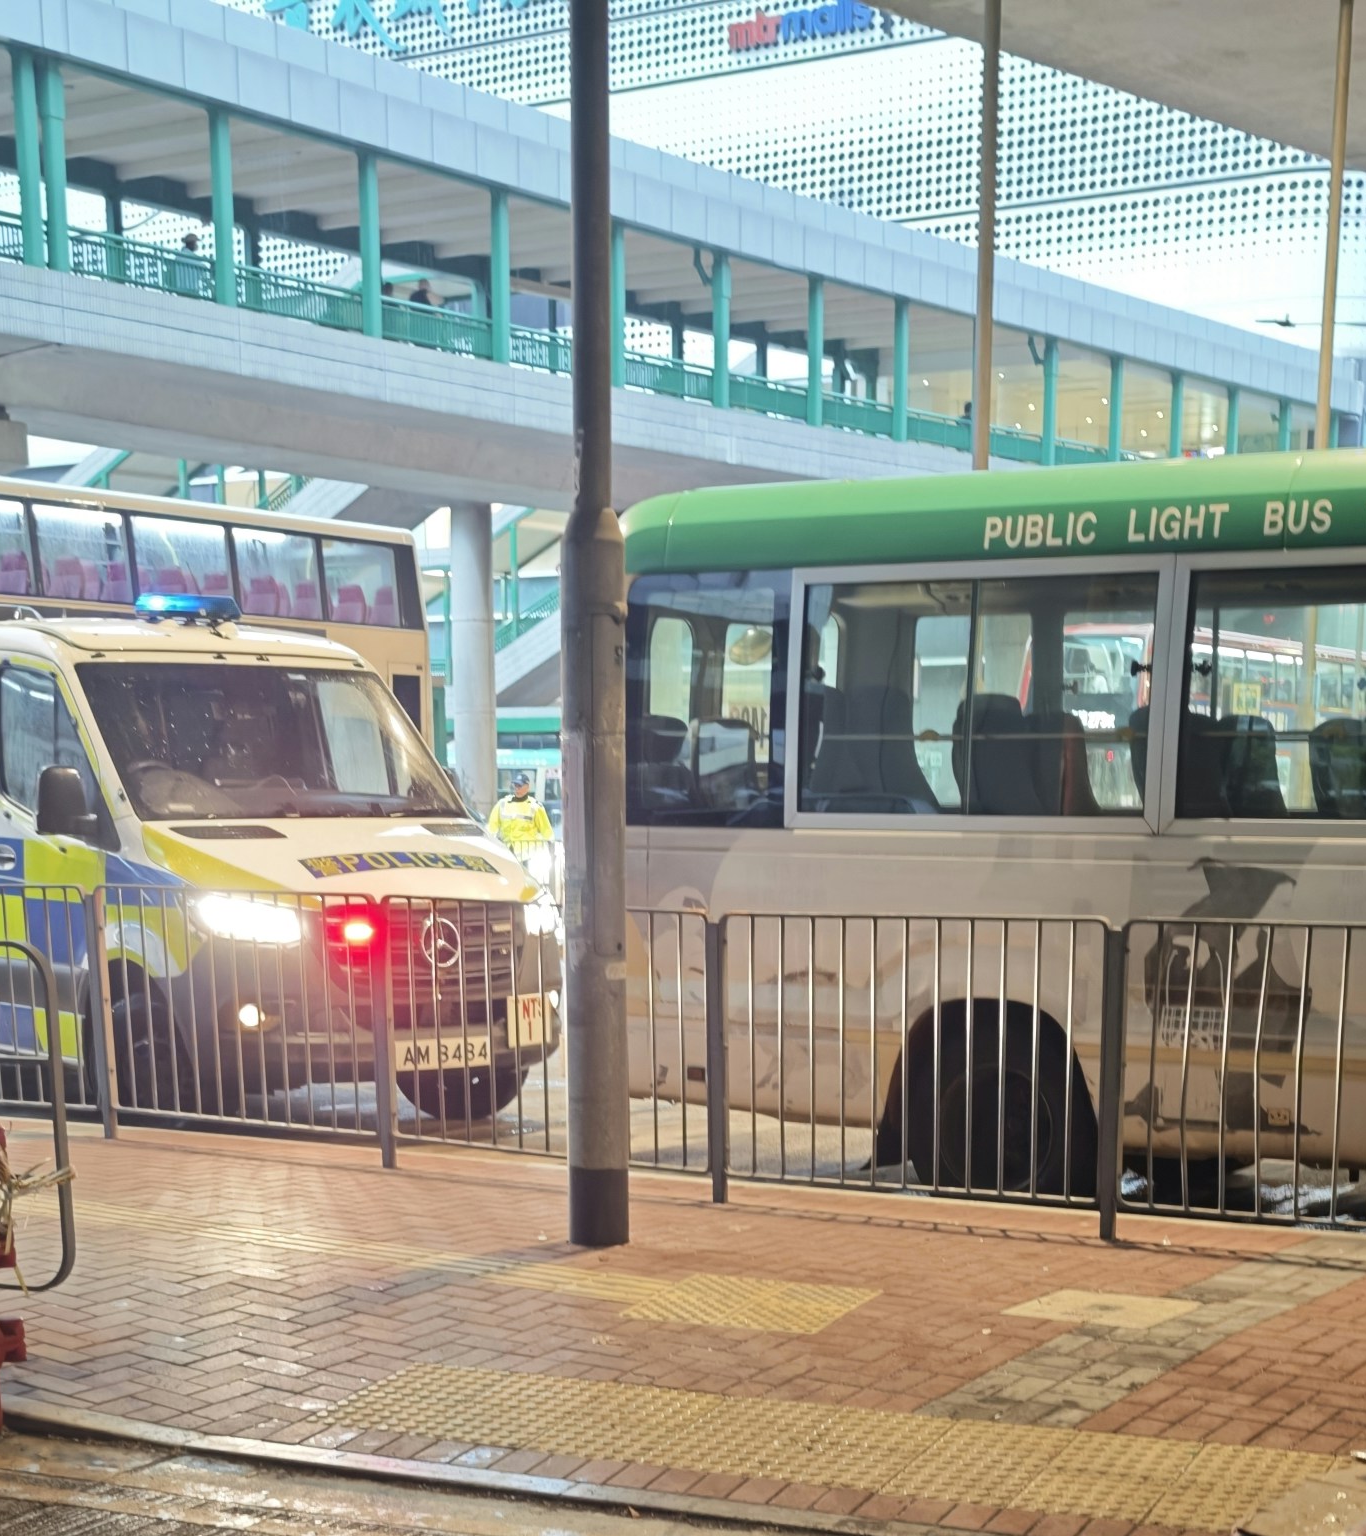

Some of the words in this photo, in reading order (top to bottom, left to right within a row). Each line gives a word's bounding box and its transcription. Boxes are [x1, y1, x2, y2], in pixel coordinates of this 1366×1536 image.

[983, 511, 1097, 550] PUBLIC
[1127, 503, 1230, 542] LIGHT
[1263, 499, 1333, 536] BUS
[336, 851, 466, 873] POLICE
[403, 1045, 431, 1067] AM
[438, 1042, 489, 1063] 8484
